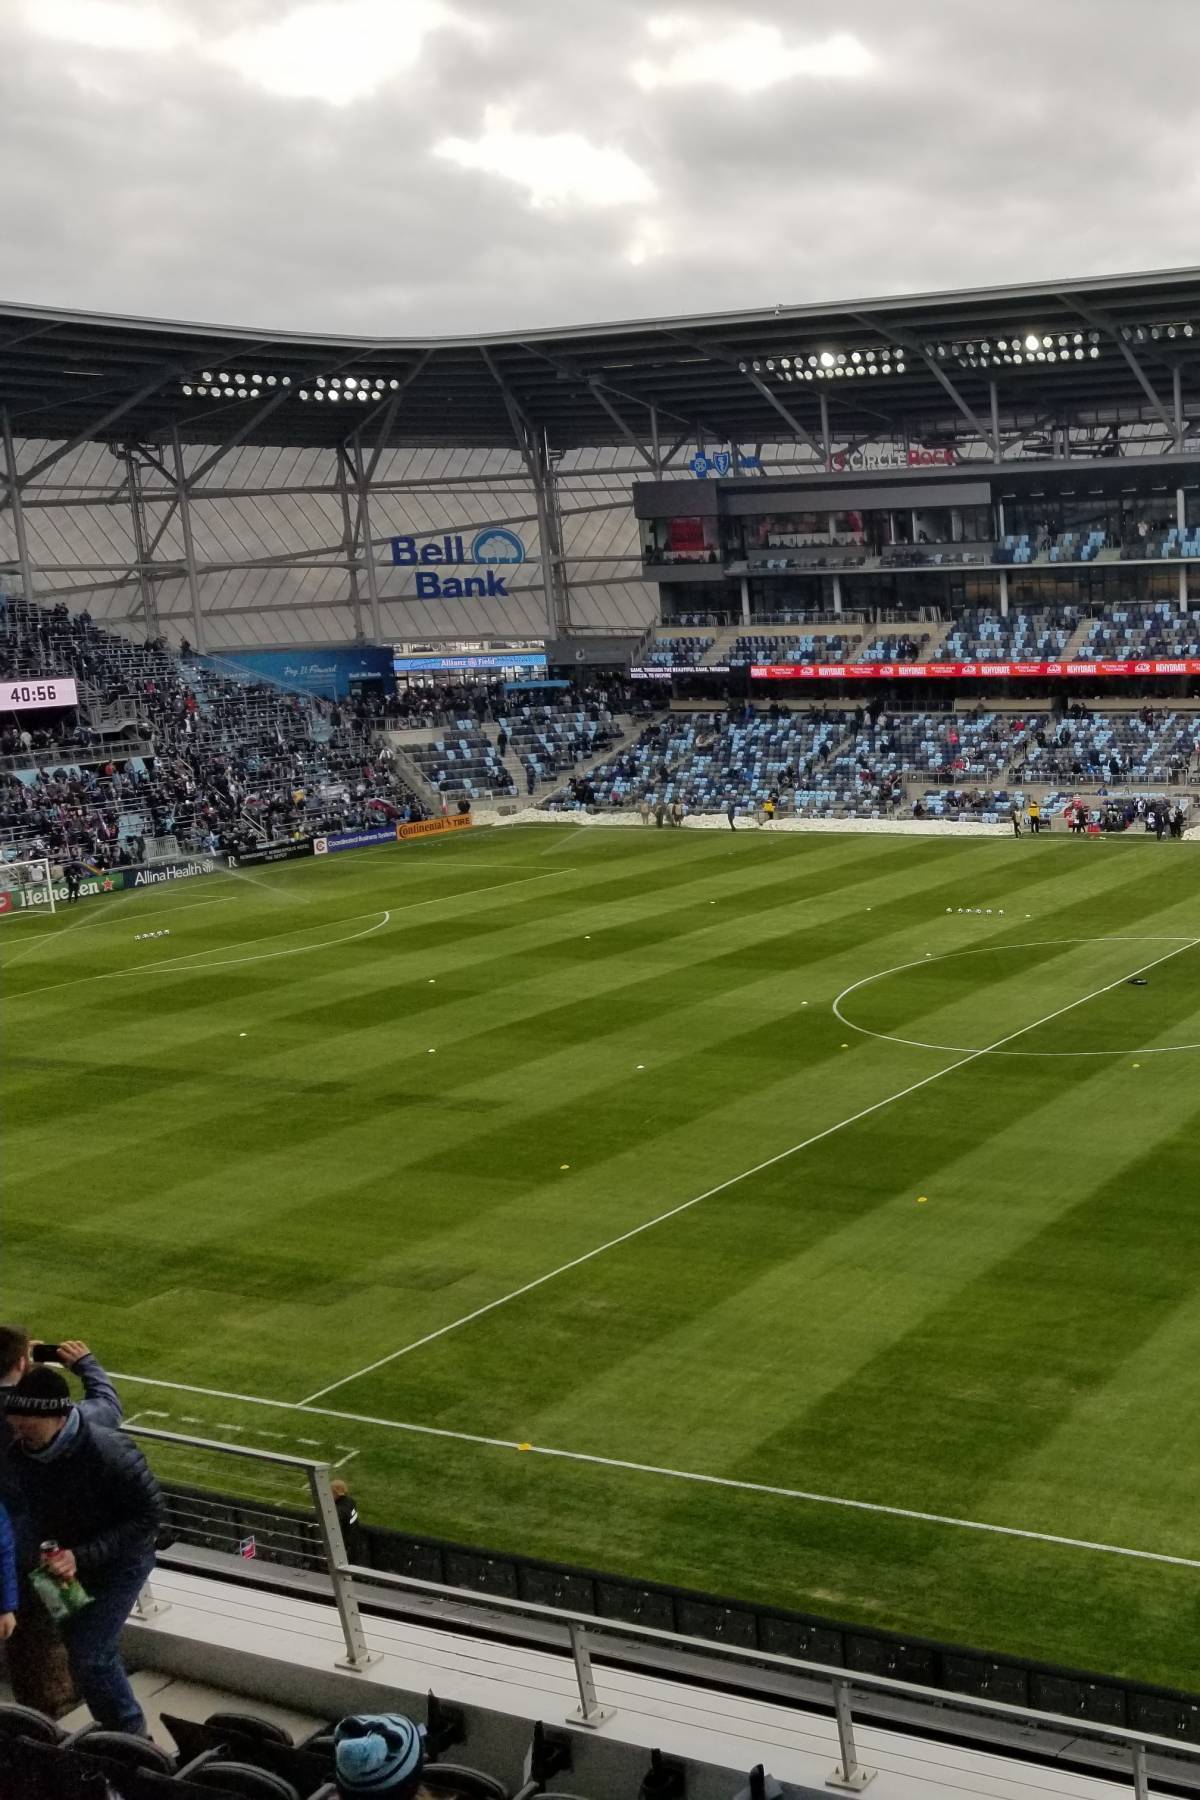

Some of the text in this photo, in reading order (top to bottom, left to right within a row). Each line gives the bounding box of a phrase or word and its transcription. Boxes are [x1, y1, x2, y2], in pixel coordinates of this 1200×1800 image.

[850, 451, 906, 470] CIRCLE
[390, 536, 465, 566] Bell
[415, 570, 509, 599] Bank
[10, 685, 57, 702] 40:56
[399, 817, 470, 838] Continental TIRE
[135, 863, 202, 886] Allina Health
[20, 881, 100, 907] Heineen
[10, 1396, 58, 1410] UNITED
